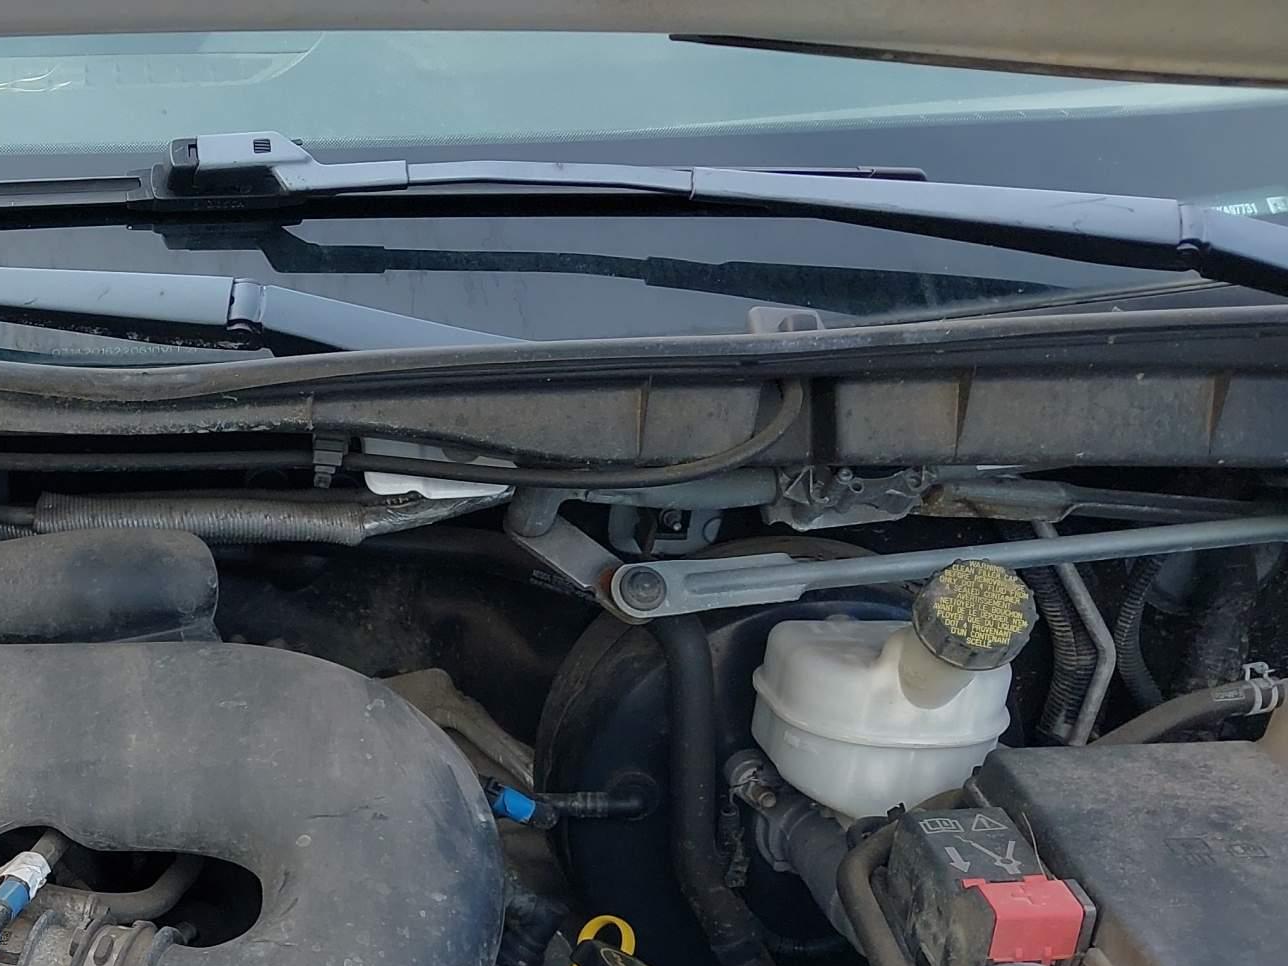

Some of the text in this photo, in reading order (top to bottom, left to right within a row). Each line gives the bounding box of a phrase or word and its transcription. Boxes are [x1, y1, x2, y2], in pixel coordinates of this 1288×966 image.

[944, 570, 970, 581] BEFORE
[952, 564, 975, 575] CLEAN
[1004, 574, 1018, 582] CAP
[939, 575, 958, 585] ONLY
[962, 579, 975, 588] DOT
[987, 584, 1006, 595] FLUID
[1010, 589, 1029, 600] FROM
[954, 585, 980, 596] SEALED
[983, 590, 1021, 604] CONTAINER
[933, 602, 954, 613] AVANT
[957, 606, 966, 615] DE
[968, 609, 978, 617] LE
[939, 597, 1023, 619] NETTOYER LE BOUCHON
[956, 593, 1011, 609] AVERTISSEMENT
[937, 610, 1022, 634] PLOYER QUE DU LIQUIDE
[944, 618, 959, 628] DOT
[971, 622, 1012, 638] PROVENANT
[950, 626, 1011, 645] D'UN CONTENANT
